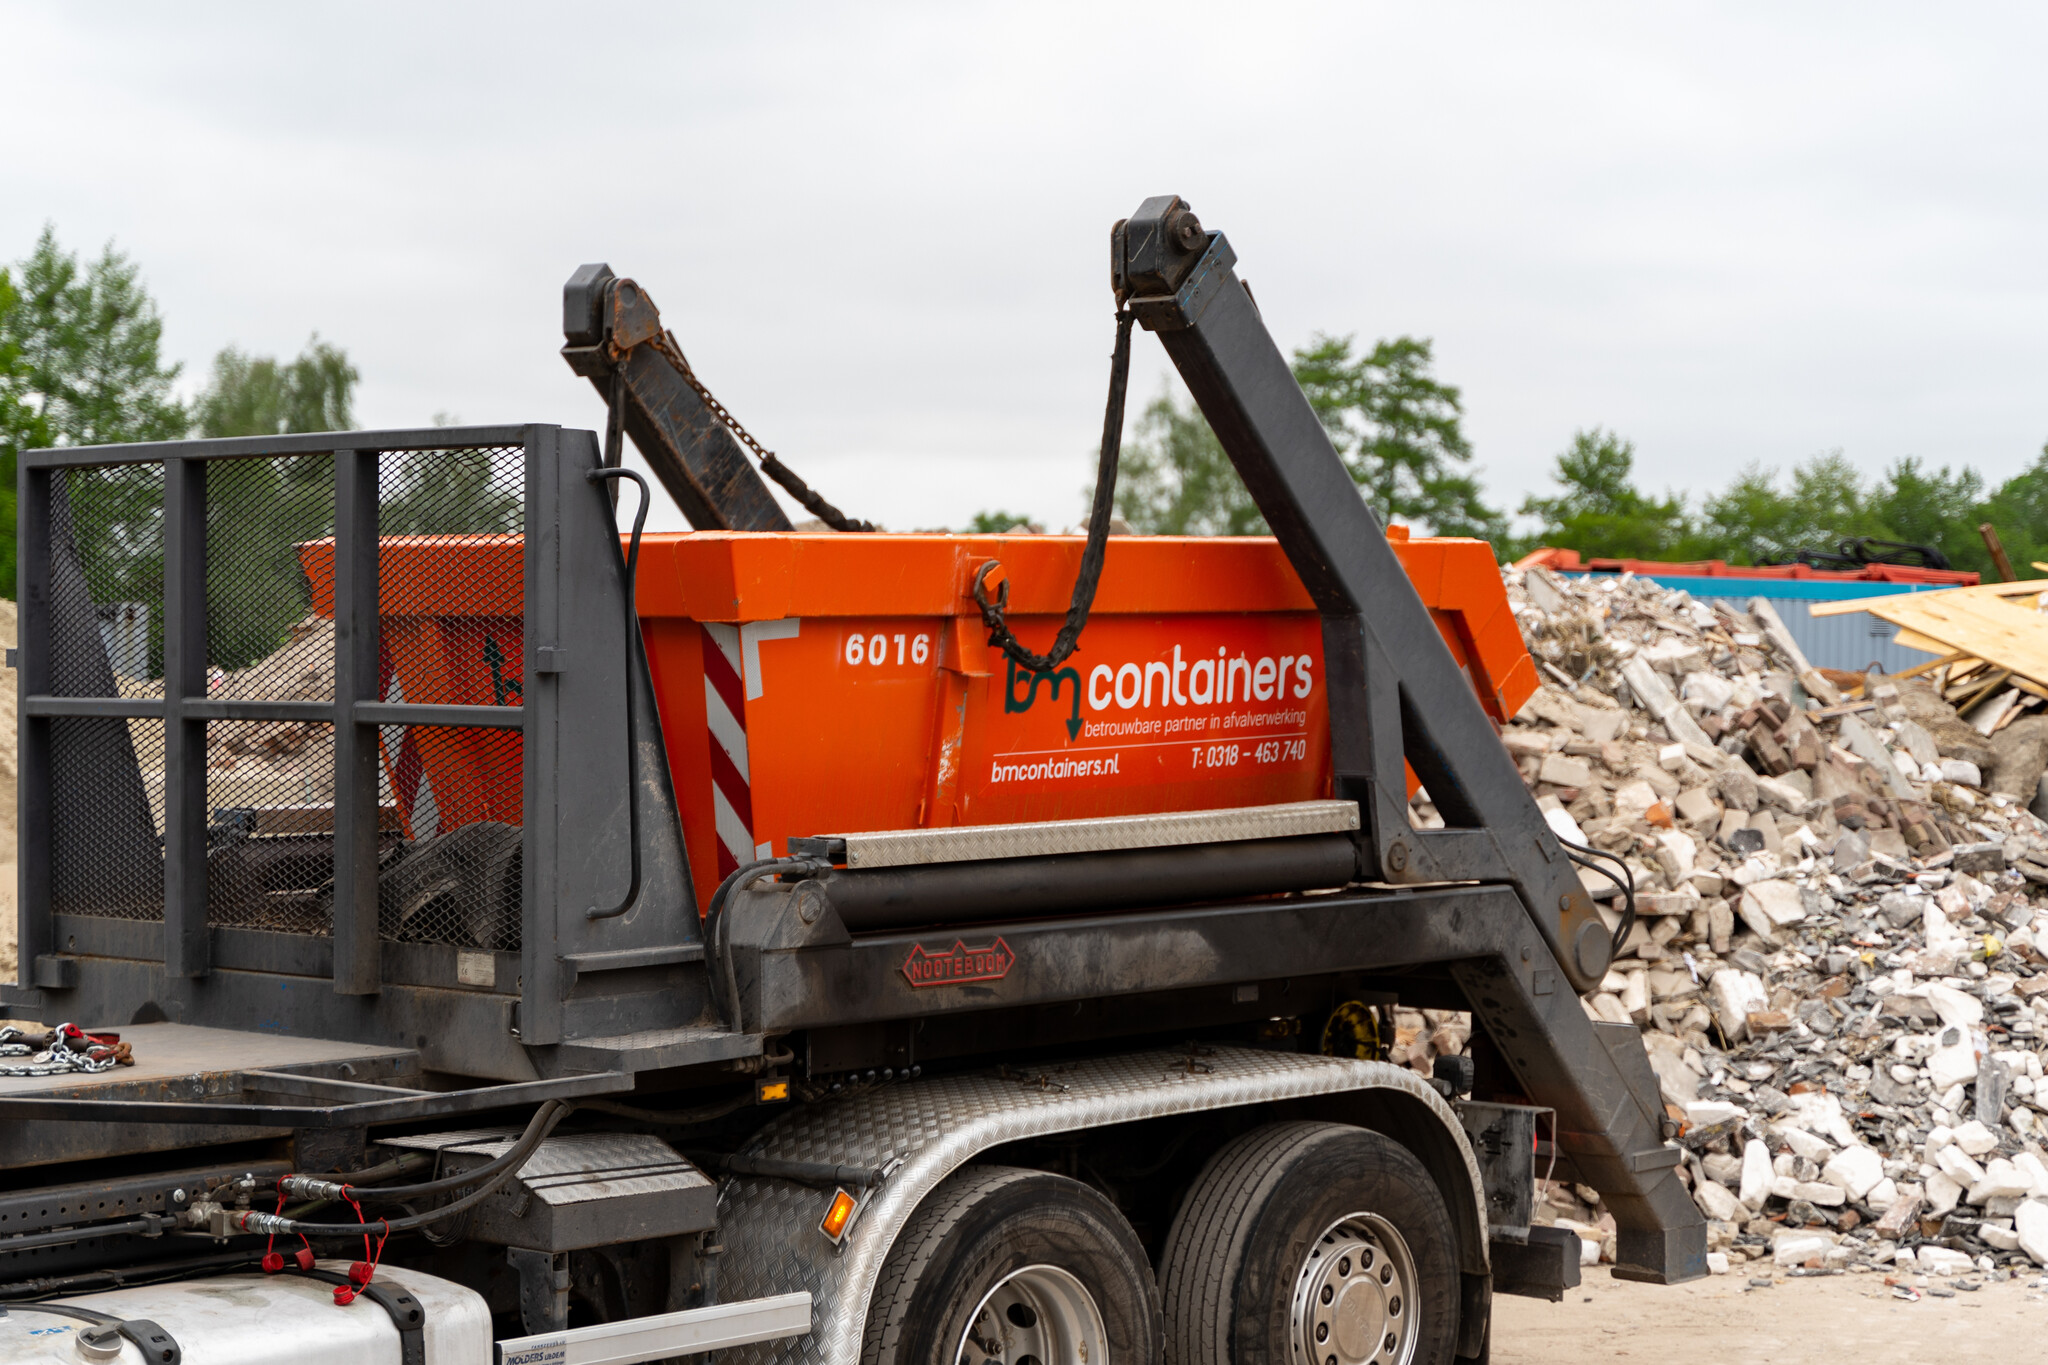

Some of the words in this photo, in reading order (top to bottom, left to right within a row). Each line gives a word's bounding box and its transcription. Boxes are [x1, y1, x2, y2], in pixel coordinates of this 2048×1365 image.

[845, 633, 930, 667] 6016
[1088, 644, 1313, 711] containers
[1084, 717, 1162, 738] betrouwbare
[1164, 715, 1207, 737] partner
[1210, 713, 1221, 730] in
[1223, 708, 1306, 729] afvalverwerking
[991, 753, 1120, 783] bmcontainers.nl
[1192, 747, 1203, 769] T:
[1206, 744, 1239, 768] 0318
[1254, 741, 1280, 764] 463
[1282, 739, 1307, 762] 740
[912, 954, 1006, 979] NOOTEBOOM
